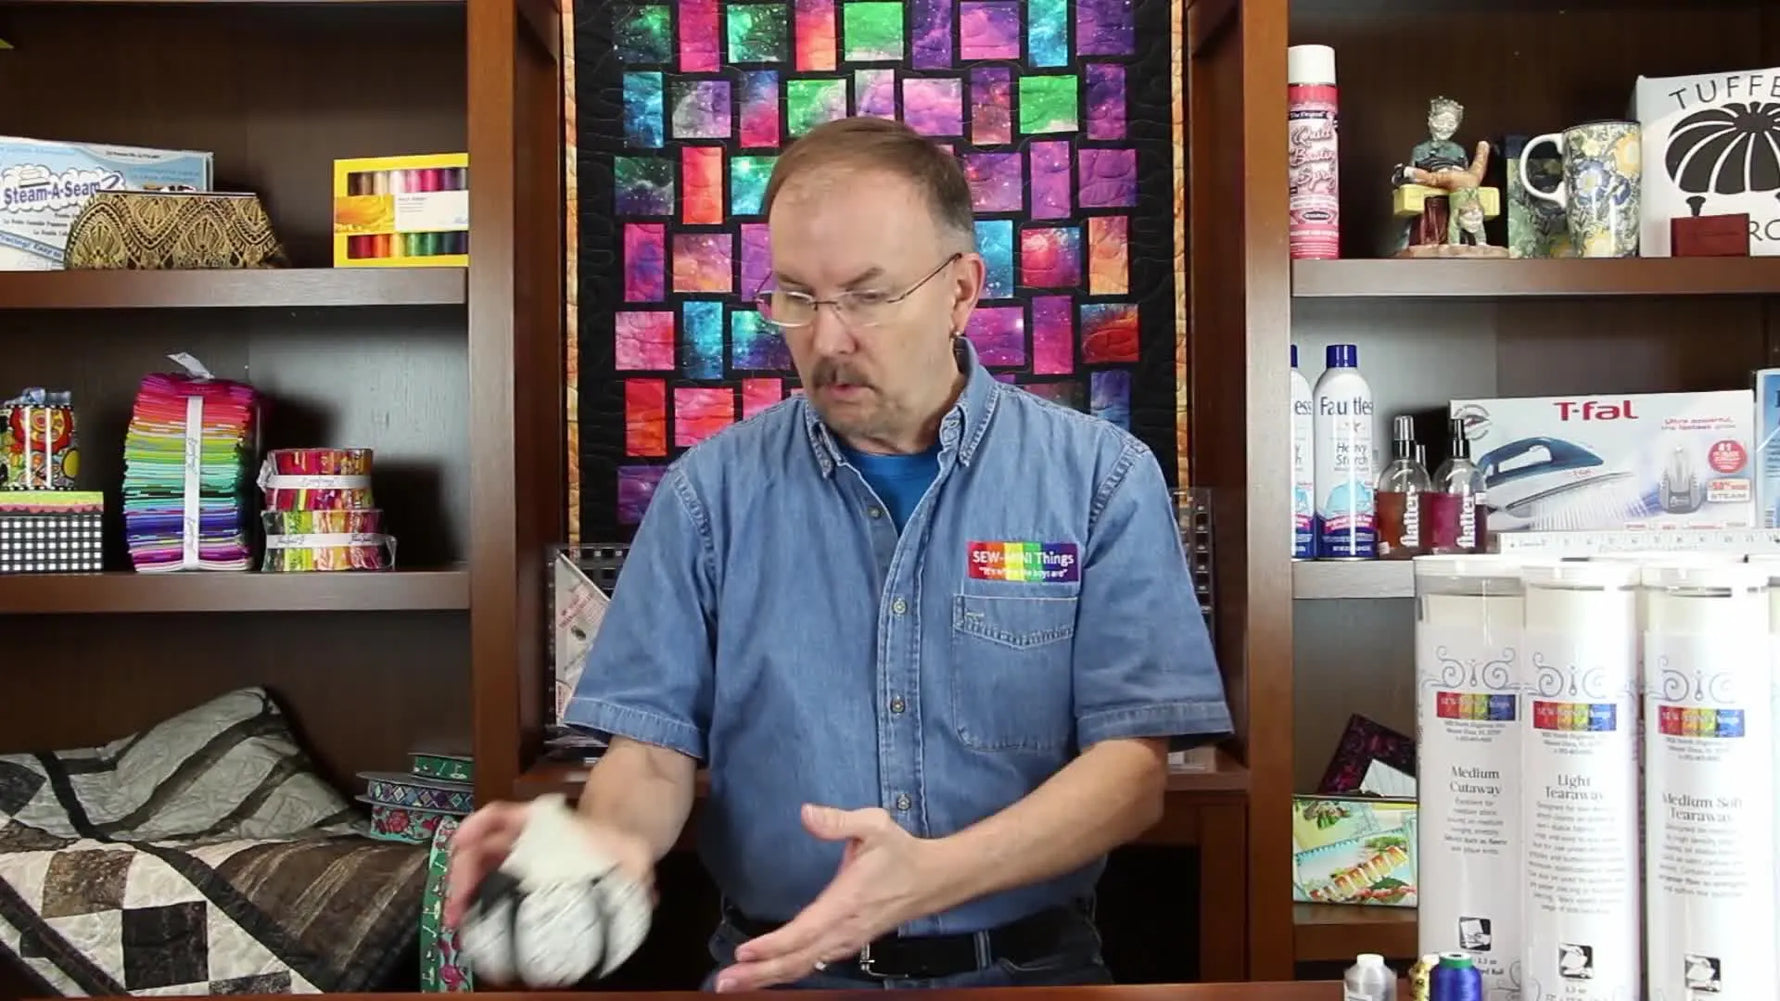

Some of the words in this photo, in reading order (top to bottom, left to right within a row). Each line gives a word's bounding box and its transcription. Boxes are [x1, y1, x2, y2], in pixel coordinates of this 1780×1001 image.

[4, 180, 101, 205] Steam-A-Seam
[1034, 551, 1075, 566] Things
[1451, 765, 1500, 779] Medium
[1558, 773, 1591, 788] Light
[1449, 781, 1501, 797] Cutaway
[1546, 786, 1605, 801] Tearaway
[1661, 792, 1713, 807] Medium
[1670, 807, 1732, 822] Tearaway
